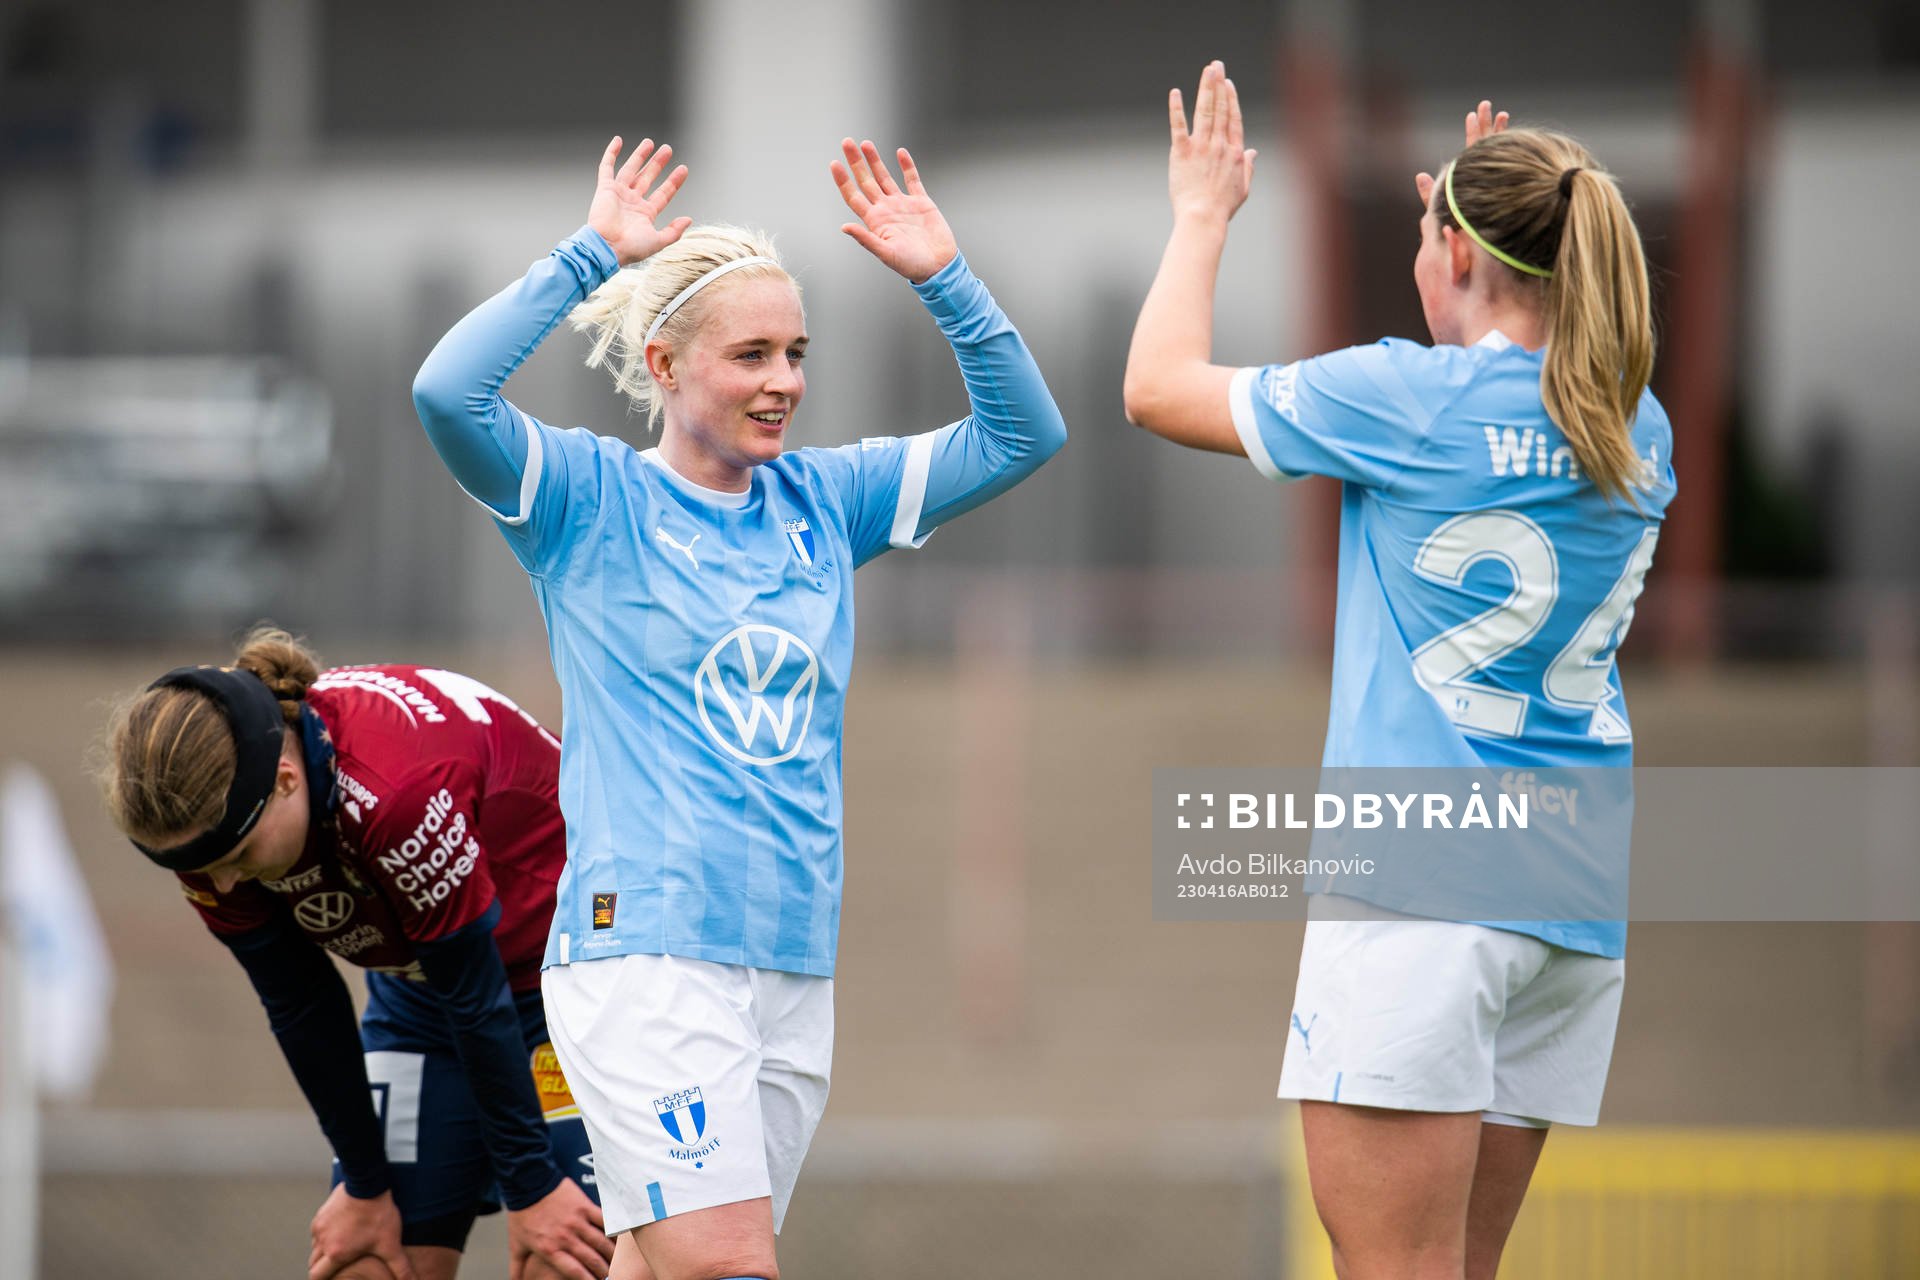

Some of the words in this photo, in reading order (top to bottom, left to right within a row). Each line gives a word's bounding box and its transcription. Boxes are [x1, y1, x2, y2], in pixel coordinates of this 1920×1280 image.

[1484, 426, 1658, 490] Wind
[1499, 771, 1578, 826] fficy
[377, 788, 453, 874] Nordic
[395, 812, 466, 893] Choice
[668, 1145, 710, 1160] Malmö
[708, 1136, 721, 1151] FF
